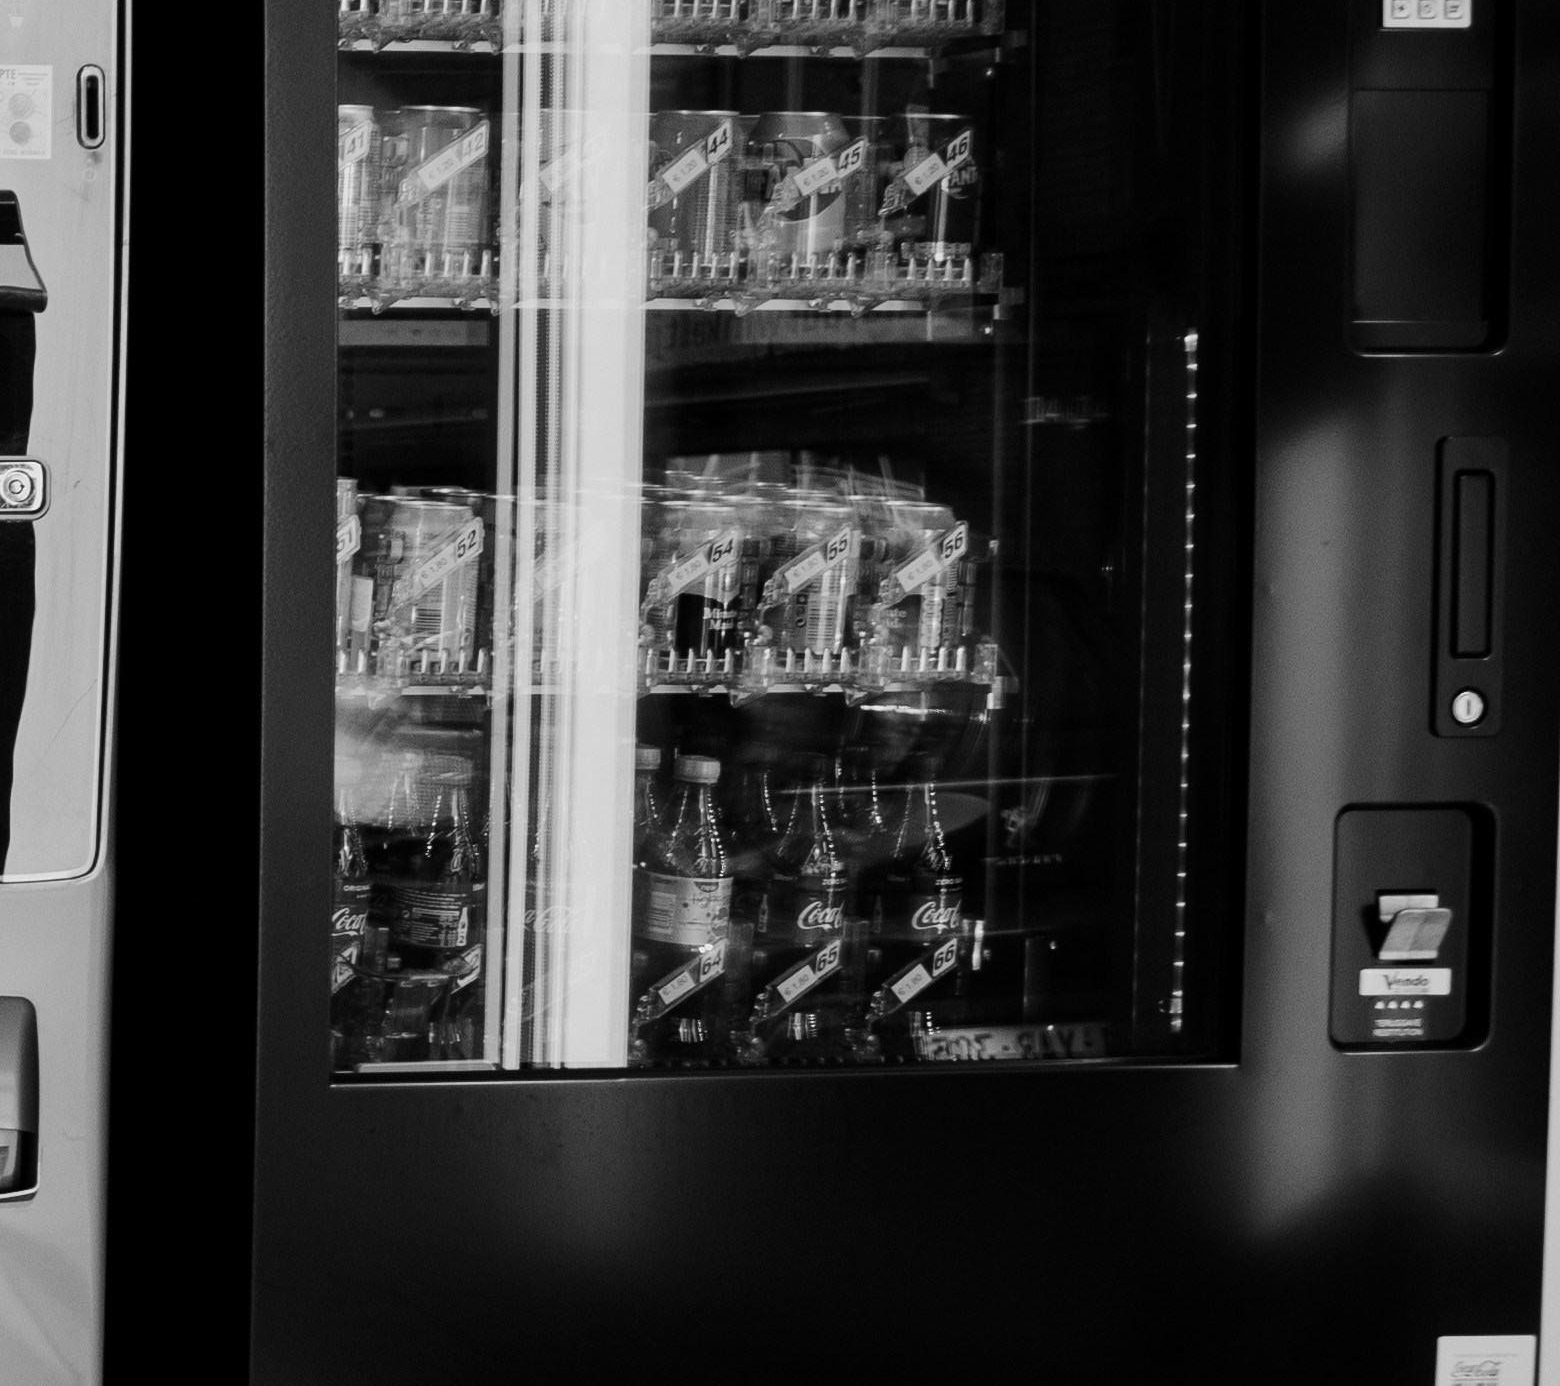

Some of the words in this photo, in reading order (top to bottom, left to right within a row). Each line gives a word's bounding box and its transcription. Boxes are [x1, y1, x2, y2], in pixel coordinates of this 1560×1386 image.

[347, 134, 364, 155] 41
[464, 132, 484, 154] 42
[708, 129, 728, 155] 44
[947, 138, 968, 162] 46
[839, 148, 860, 172] 45
[456, 530, 477, 558] 52
[711, 539, 734, 563] 54
[828, 536, 848, 561] 55
[943, 532, 964, 559] 56
[701, 951, 723, 975] 64
[817, 948, 839, 972] 65
[933, 946, 954, 971] 66
